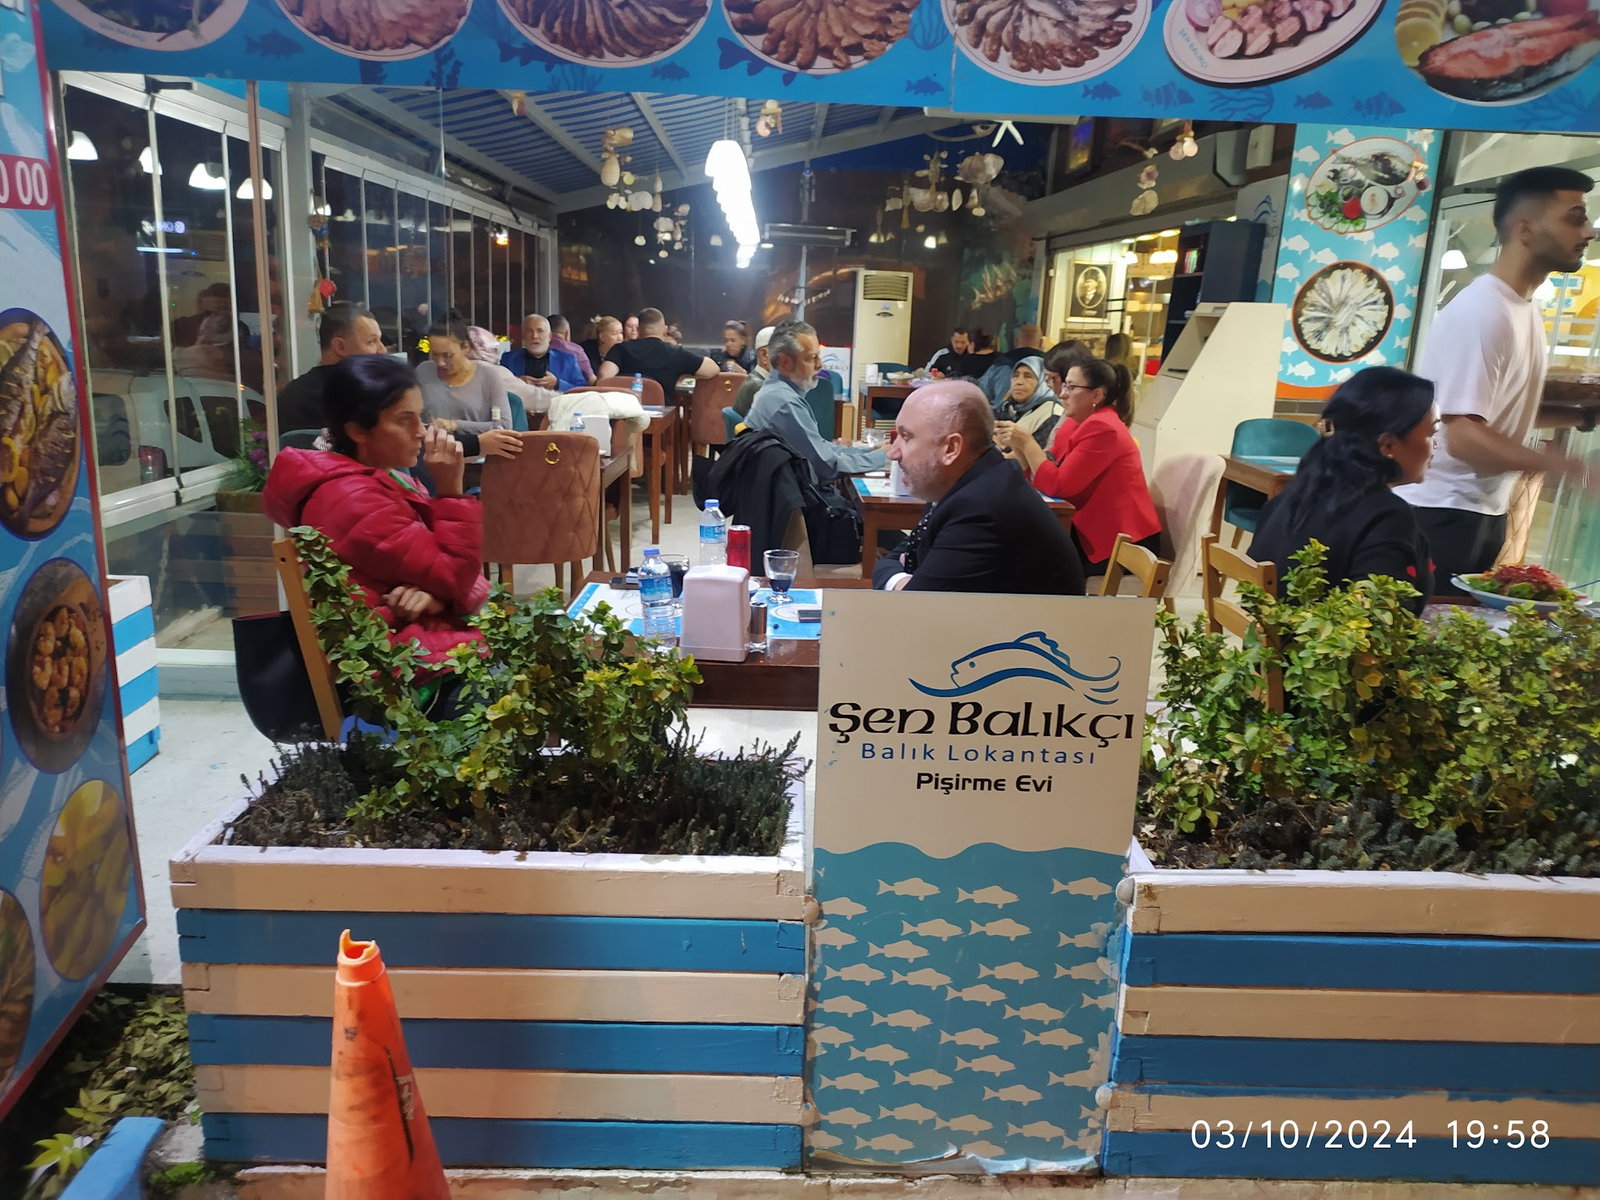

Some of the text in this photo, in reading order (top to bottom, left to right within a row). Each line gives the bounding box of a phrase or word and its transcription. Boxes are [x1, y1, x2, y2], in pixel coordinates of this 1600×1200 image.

[15, 161, 48, 206] 00
[828, 702, 1134, 747] Şen Balıkçı
[861, 743, 1094, 764] Balık Lokantası
[916, 772, 1053, 795] Pişirme Evi
